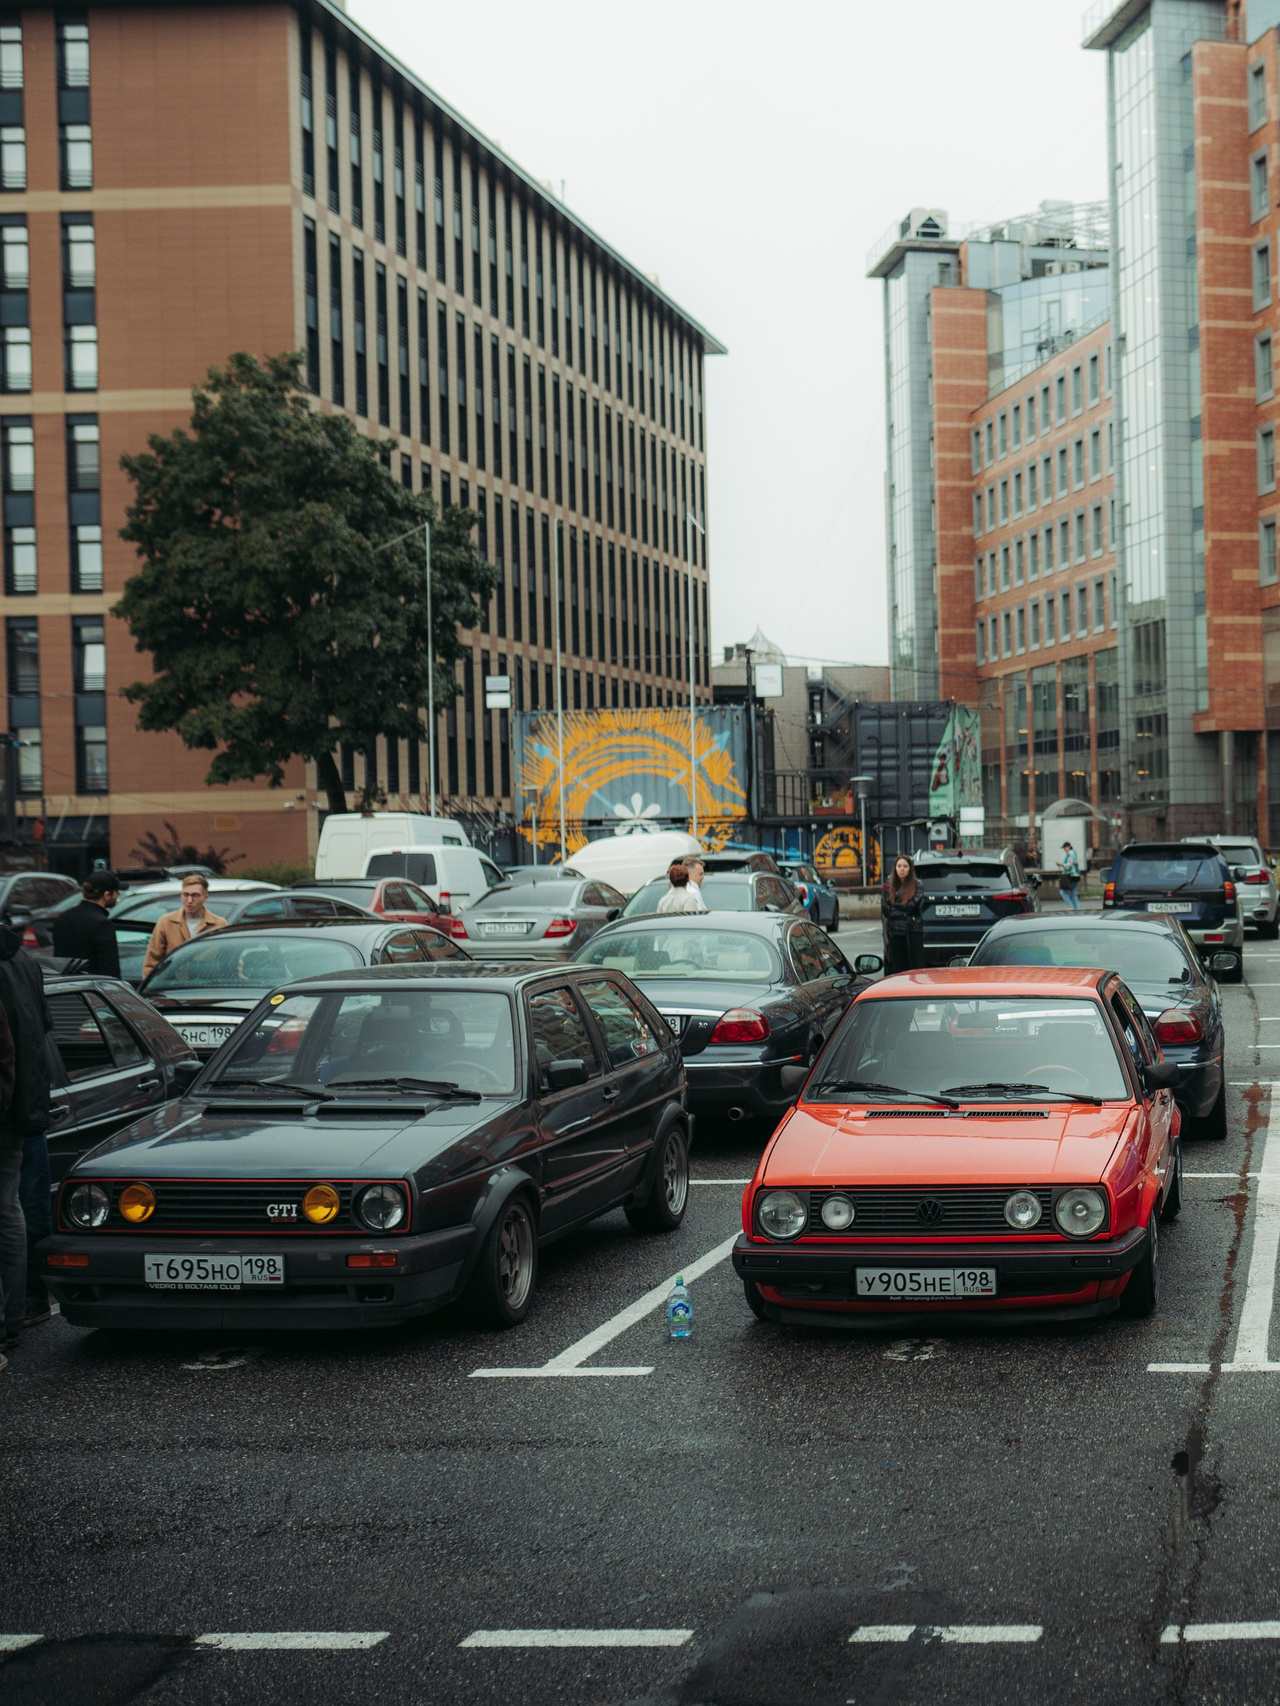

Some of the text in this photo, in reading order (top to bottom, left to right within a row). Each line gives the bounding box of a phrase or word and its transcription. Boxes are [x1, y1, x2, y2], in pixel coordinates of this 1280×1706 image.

[266, 1204, 298, 1217] GTI
[244, 1258, 277, 1274] 198
[957, 1271, 989, 1287] 198
